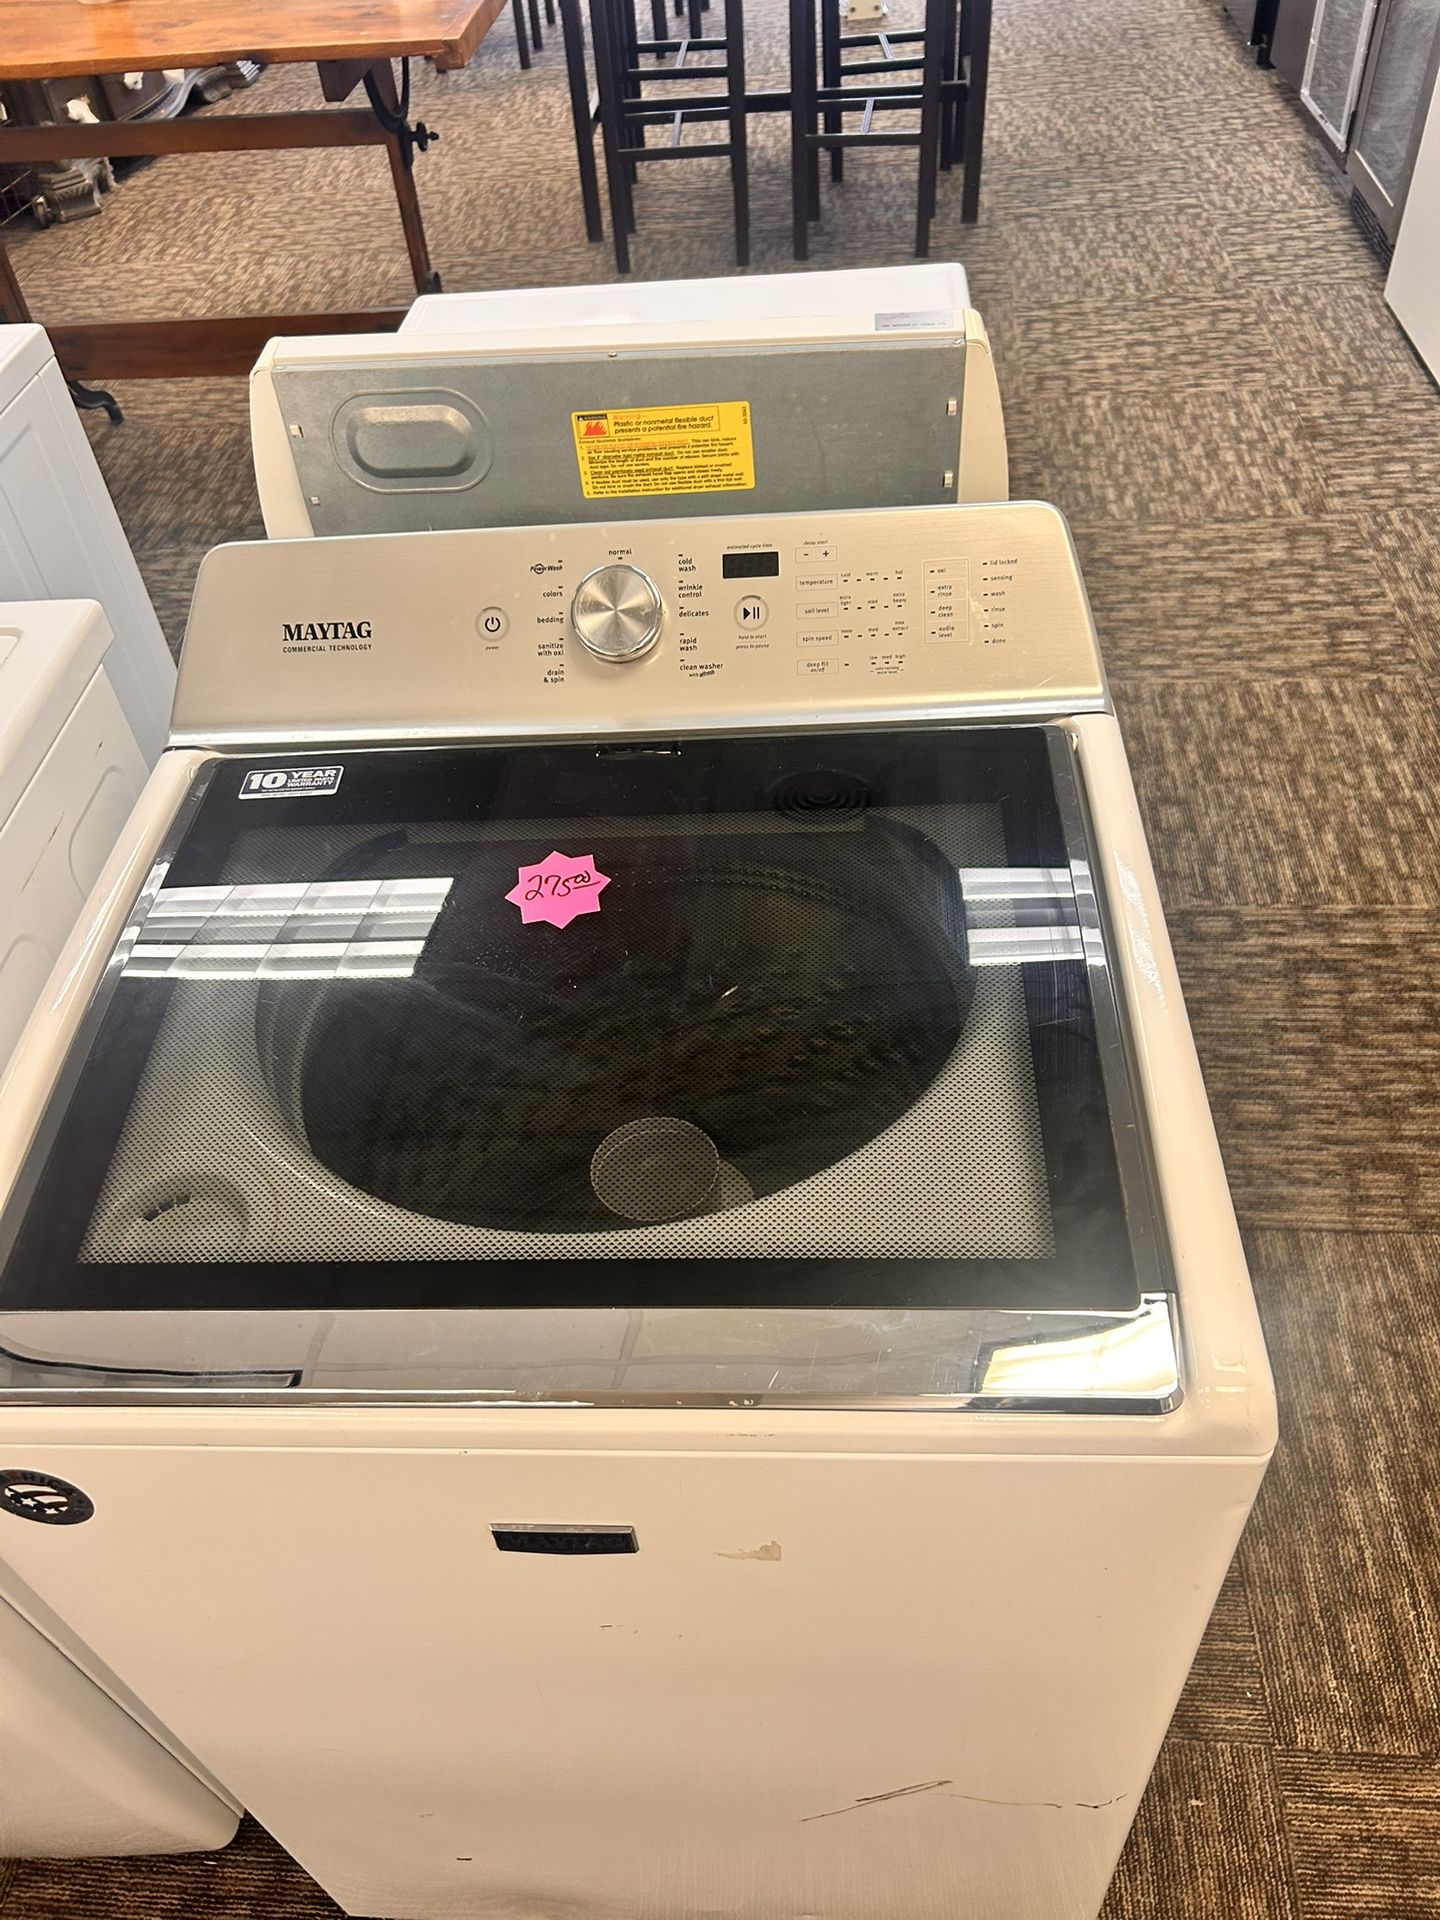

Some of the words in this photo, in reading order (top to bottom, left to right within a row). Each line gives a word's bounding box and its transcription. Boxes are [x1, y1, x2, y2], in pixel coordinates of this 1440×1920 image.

[282, 621, 372, 642] MAYTAG
[250, 773, 287, 790] 10
[292, 770, 337, 778] YEAR
